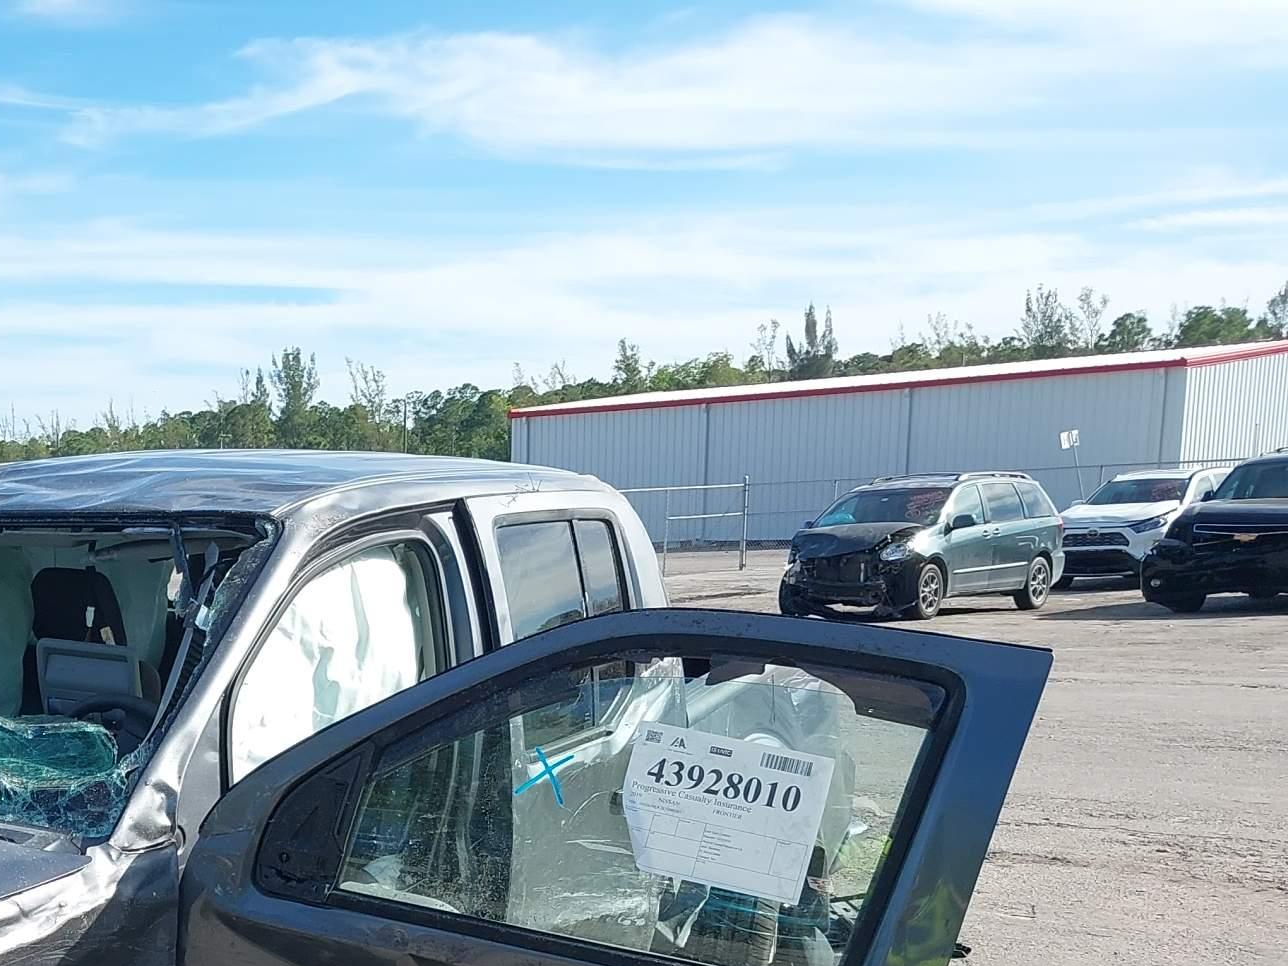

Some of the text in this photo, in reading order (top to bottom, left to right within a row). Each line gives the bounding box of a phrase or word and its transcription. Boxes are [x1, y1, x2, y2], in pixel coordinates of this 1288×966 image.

[631, 780, 753, 814] Progressive Casualty Insurance
[647, 757, 801, 812] 43928010
